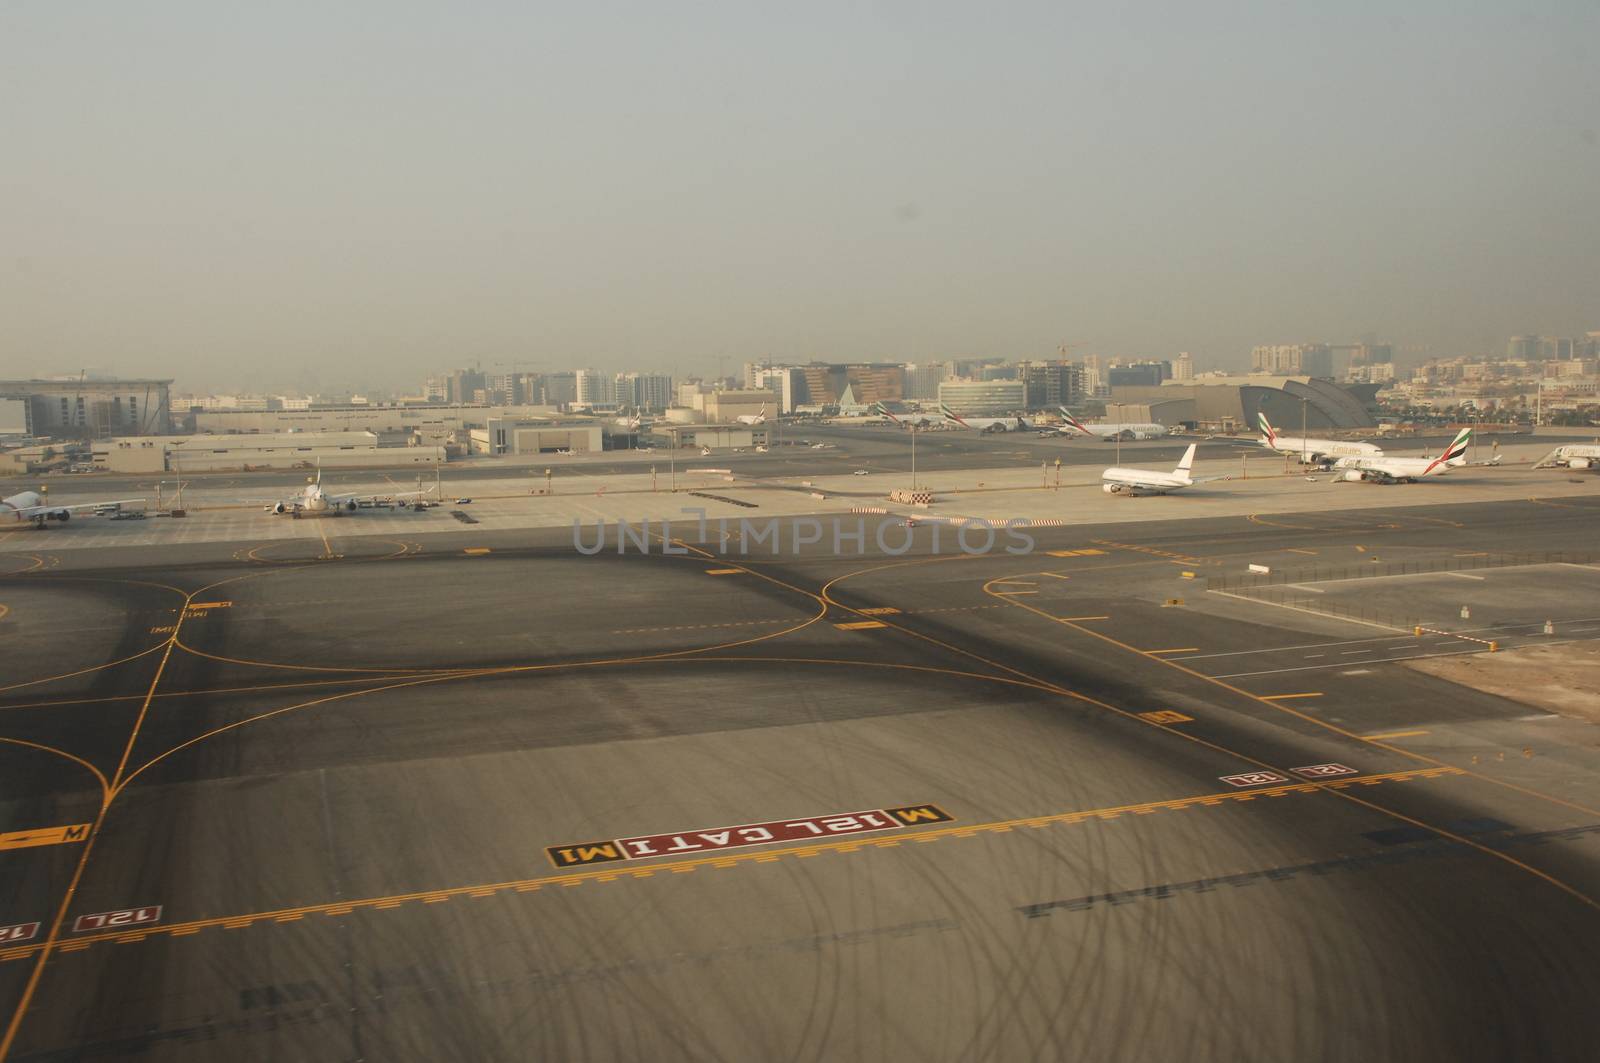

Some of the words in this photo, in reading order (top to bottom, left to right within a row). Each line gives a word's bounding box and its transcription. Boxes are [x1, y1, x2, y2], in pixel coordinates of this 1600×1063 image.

[1299, 765, 1346, 775] 12L
[1227, 772, 1277, 784] 12L
[896, 808, 941, 823] M
[784, 814, 887, 834] 12L
[63, 826, 85, 841] M
[557, 844, 618, 863] M1
[86, 909, 151, 928] 12L
